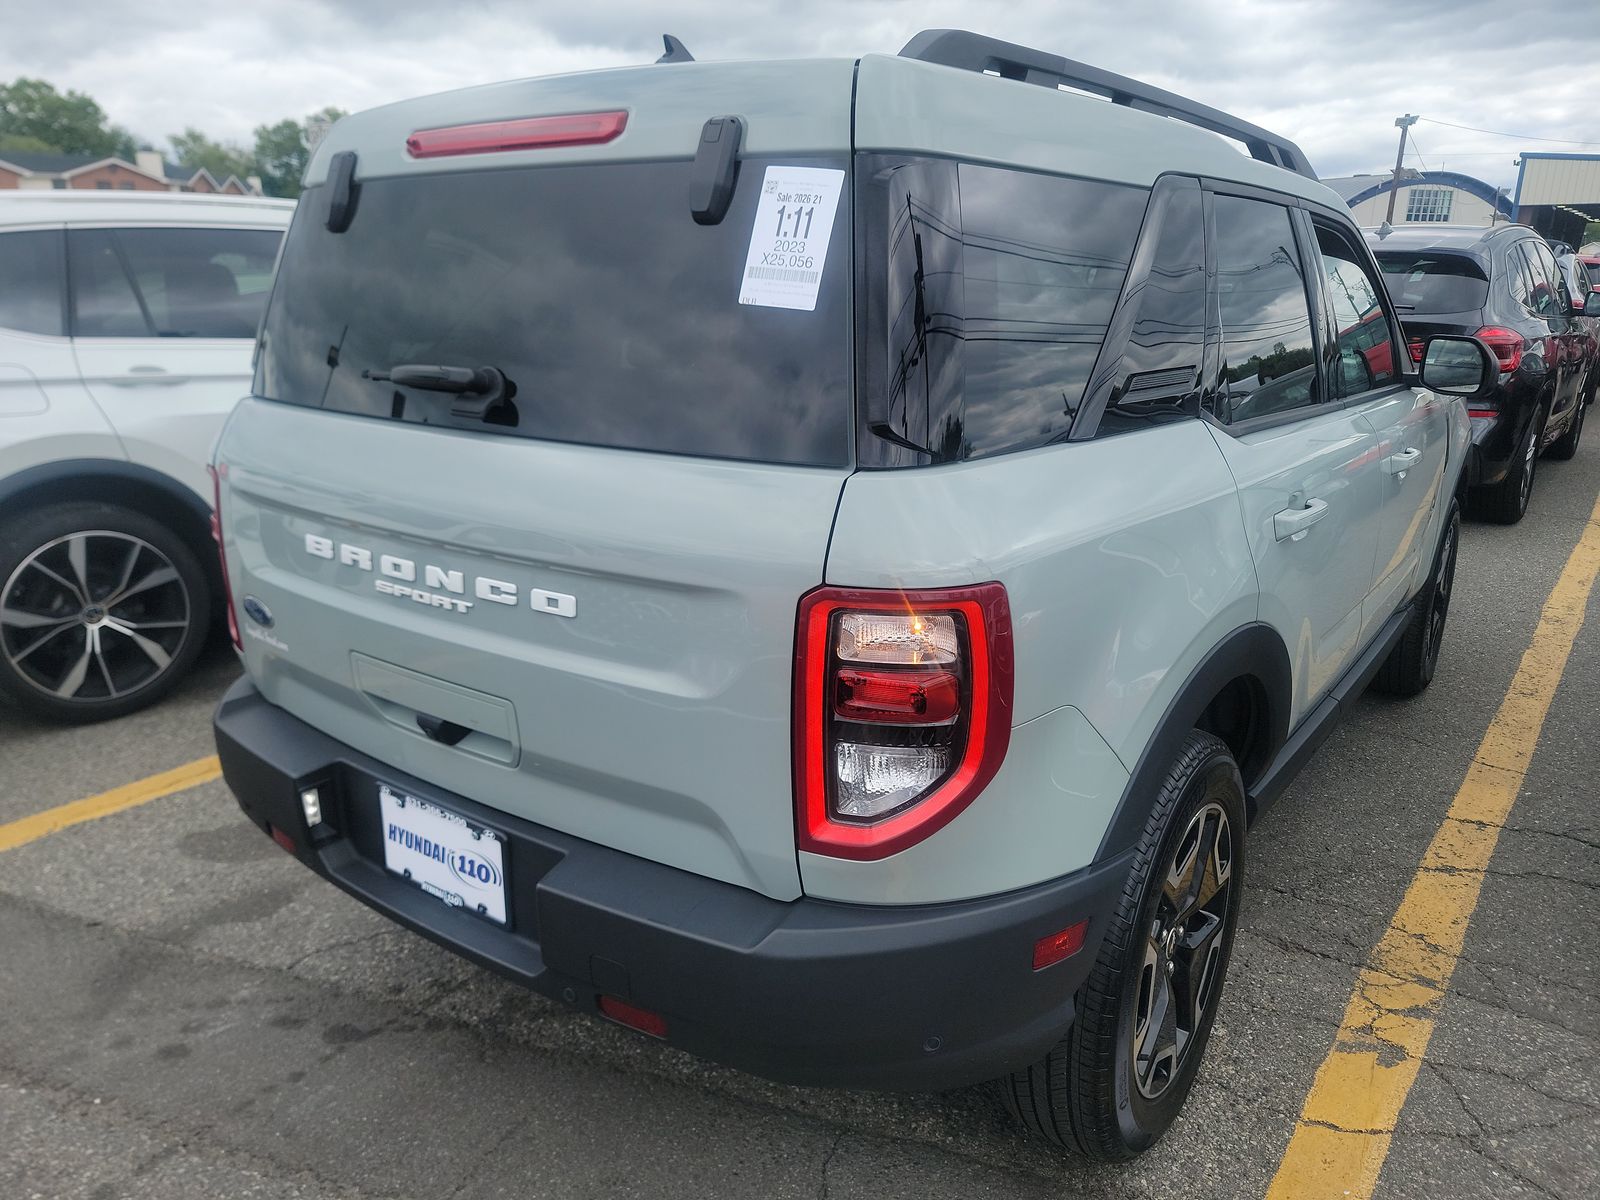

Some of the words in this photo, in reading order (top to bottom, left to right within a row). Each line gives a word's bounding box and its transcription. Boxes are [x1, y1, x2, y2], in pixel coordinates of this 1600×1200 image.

[776, 193, 793, 202] Sale
[794, 193, 811, 204] 2026
[813, 195, 823, 205] 21
[776, 205, 814, 239] 1:11
[761, 252, 814, 268] X25,056
[774, 240, 806, 253] 2023
[305, 533, 577, 618] BRONCO
[374, 579, 474, 613] SPORT
[388, 823, 446, 864] HYUNDAI
[458, 855, 491, 884] 110
